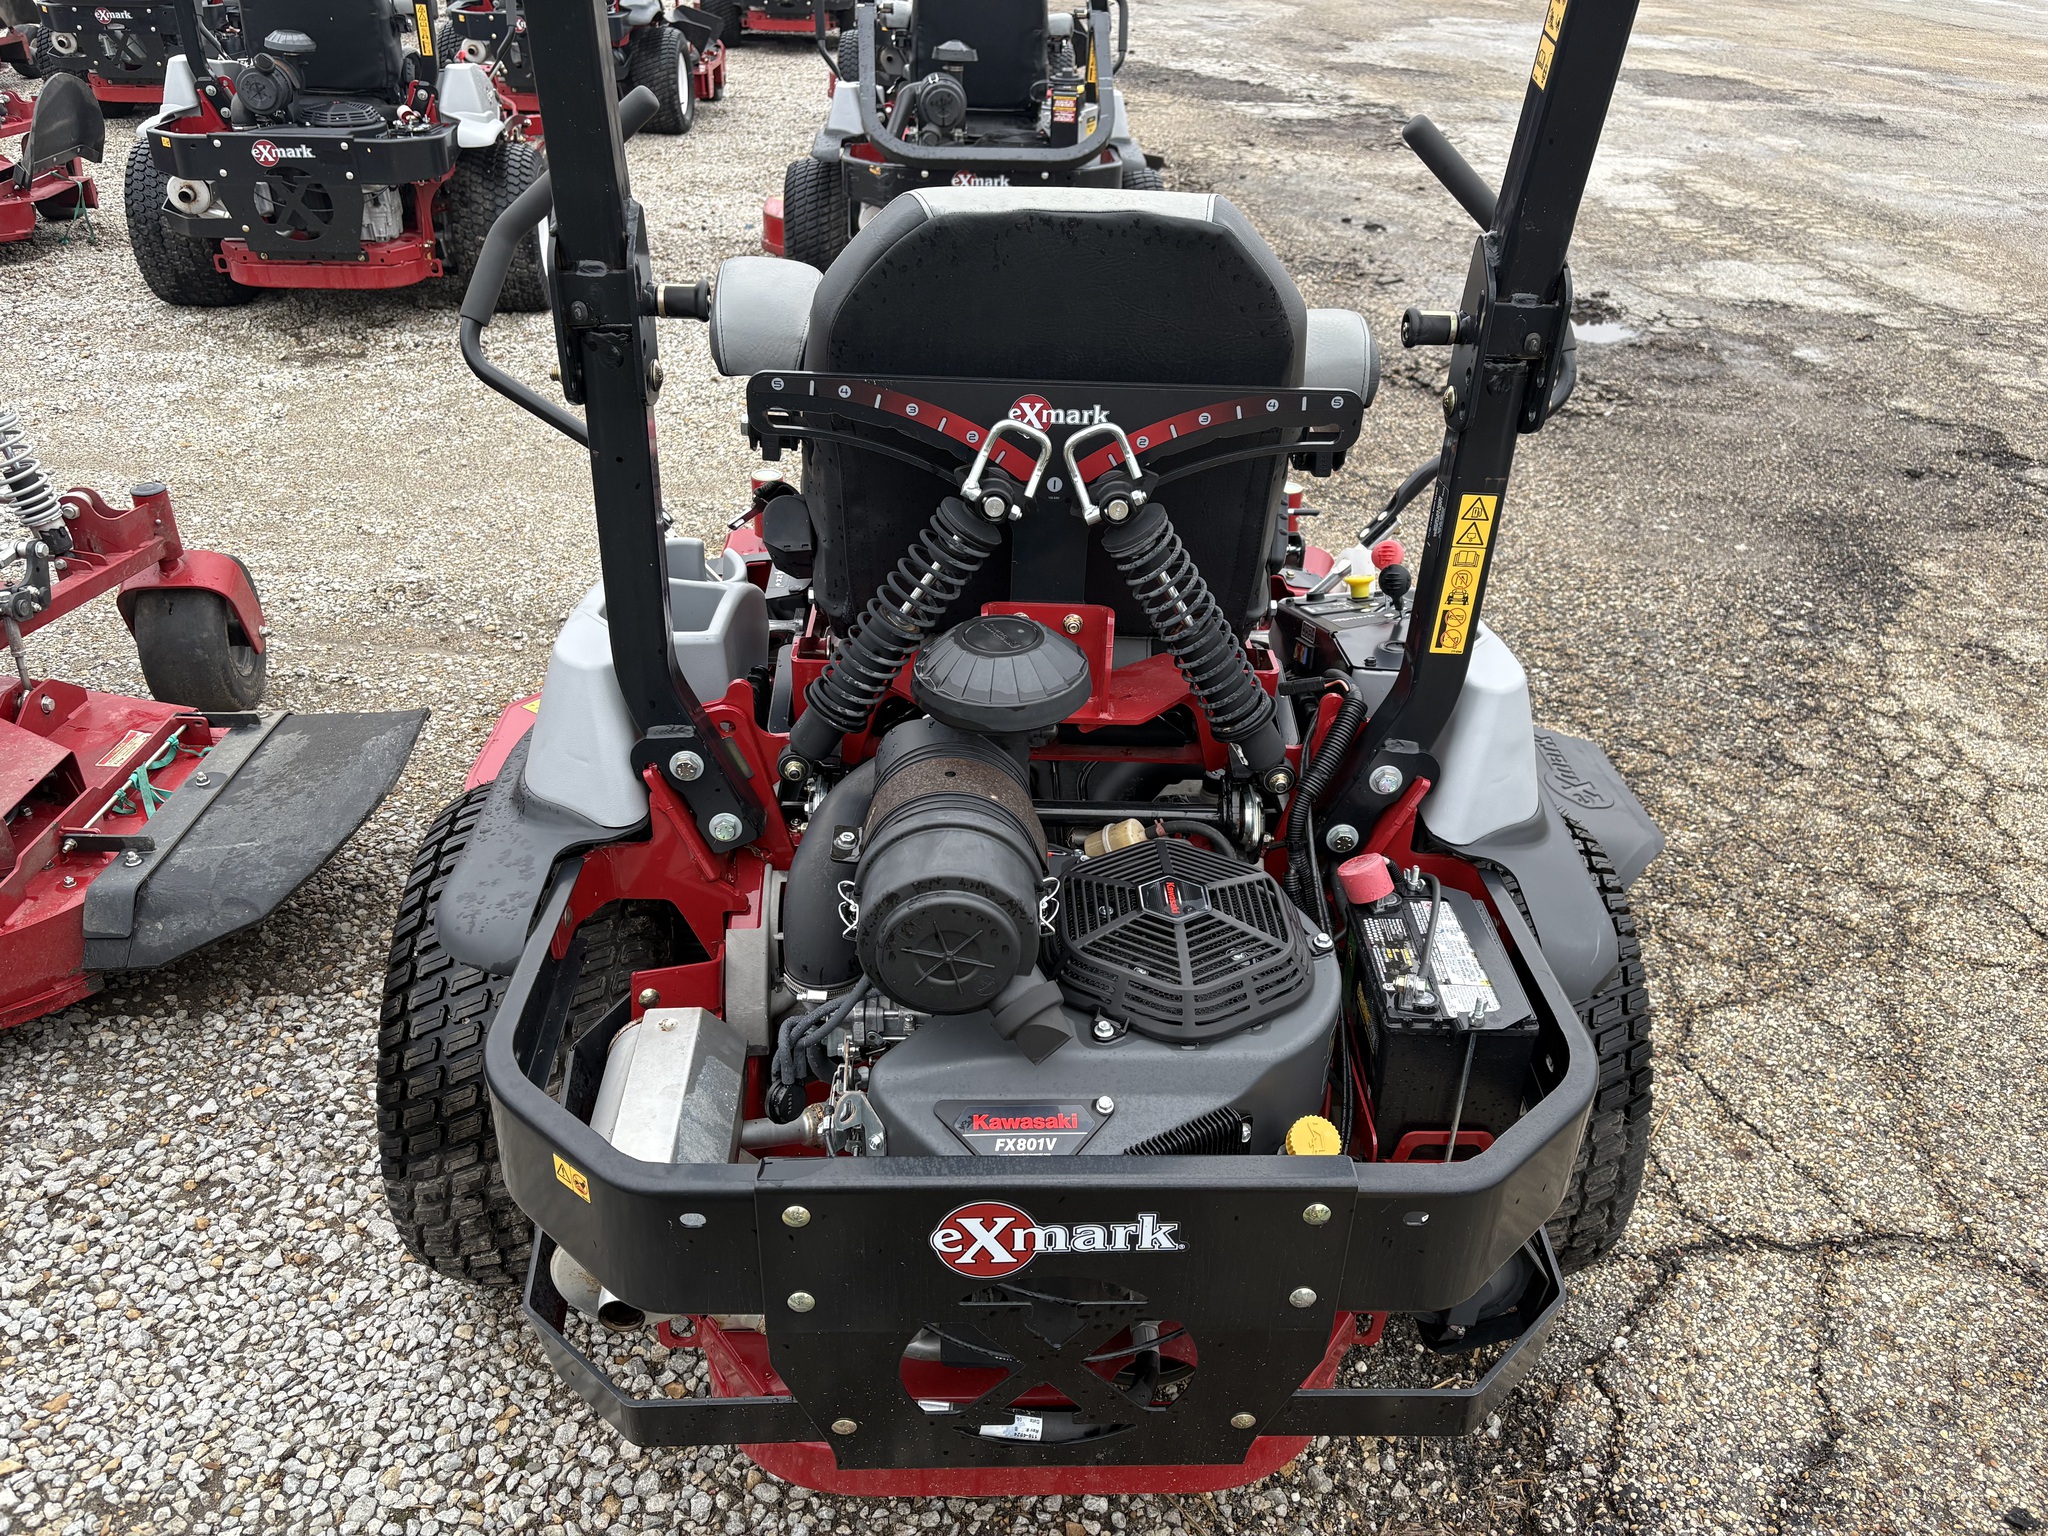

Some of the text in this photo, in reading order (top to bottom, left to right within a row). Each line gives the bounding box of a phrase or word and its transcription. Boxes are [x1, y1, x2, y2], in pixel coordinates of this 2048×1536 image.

[251, 143, 316, 163] eXmark
[1008, 401, 1110, 430] eXmark
[1165, 881, 1181, 915] Kawasaki
[973, 1113, 1078, 1131] Kawasaki
[994, 1137, 1057, 1151] FX801V
